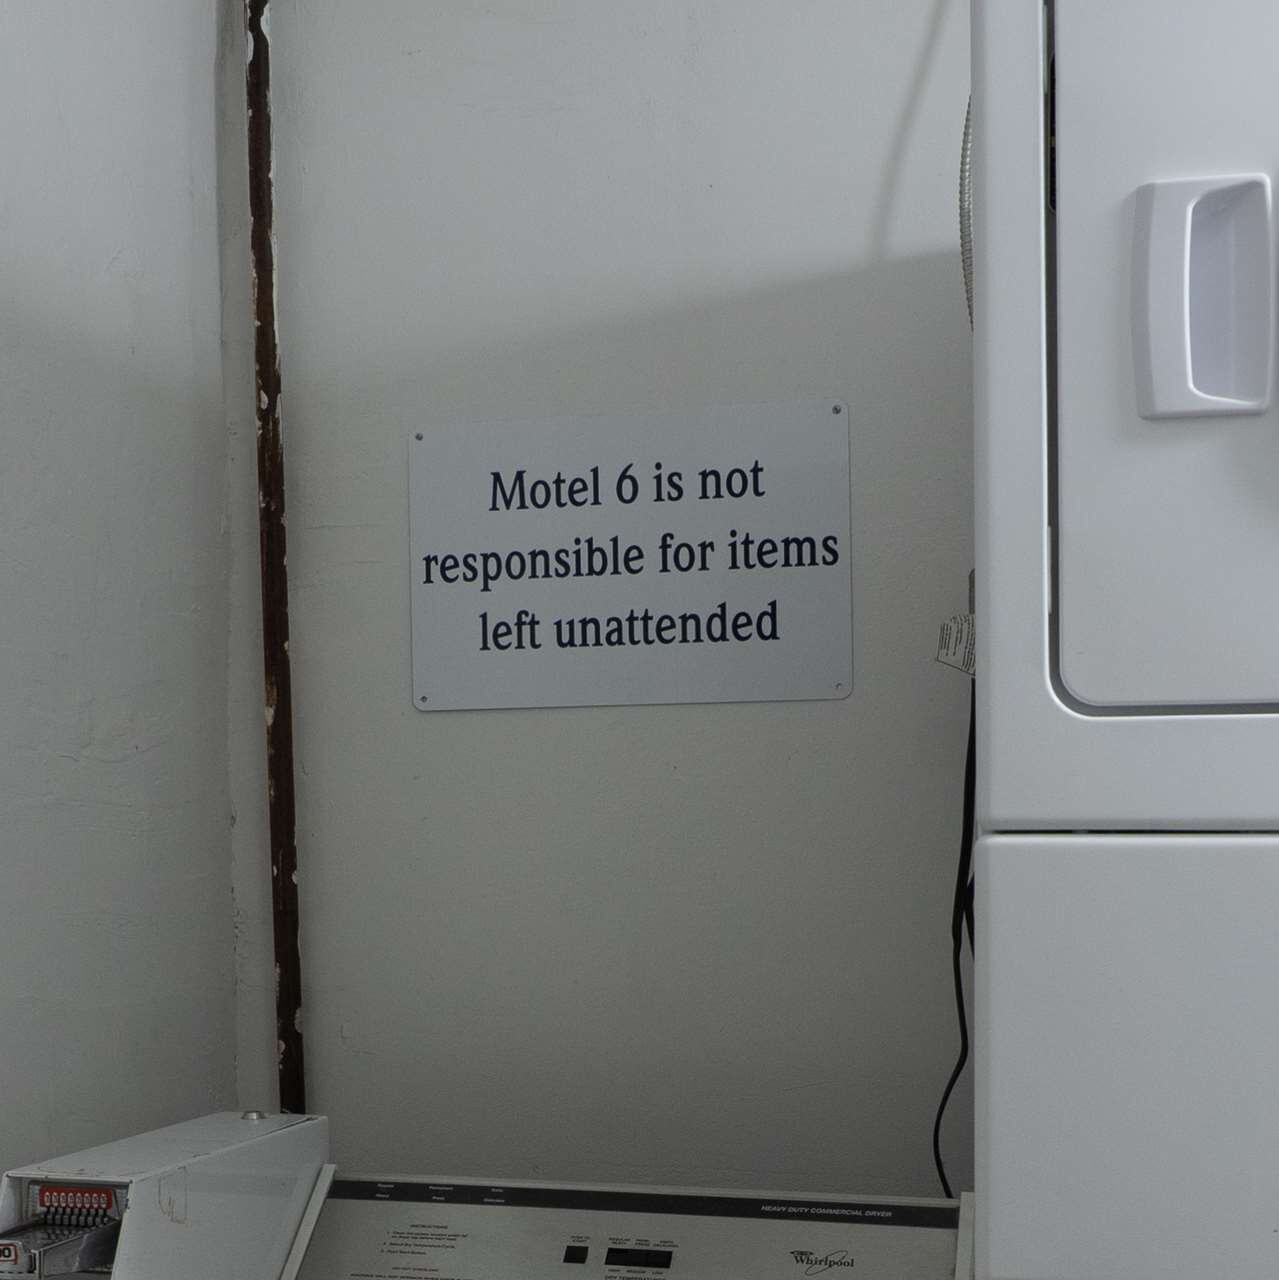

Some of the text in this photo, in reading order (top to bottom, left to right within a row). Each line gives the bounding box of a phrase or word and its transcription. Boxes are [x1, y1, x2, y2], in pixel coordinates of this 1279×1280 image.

[489, 460, 766, 511] Motel 6 is not
[422, 529, 839, 592] responsible for items
[479, 600, 780, 651] left unattended
[811, 1208, 862, 1216] COMMERCIAL
[794, 1256, 854, 1267] Whirlpool
